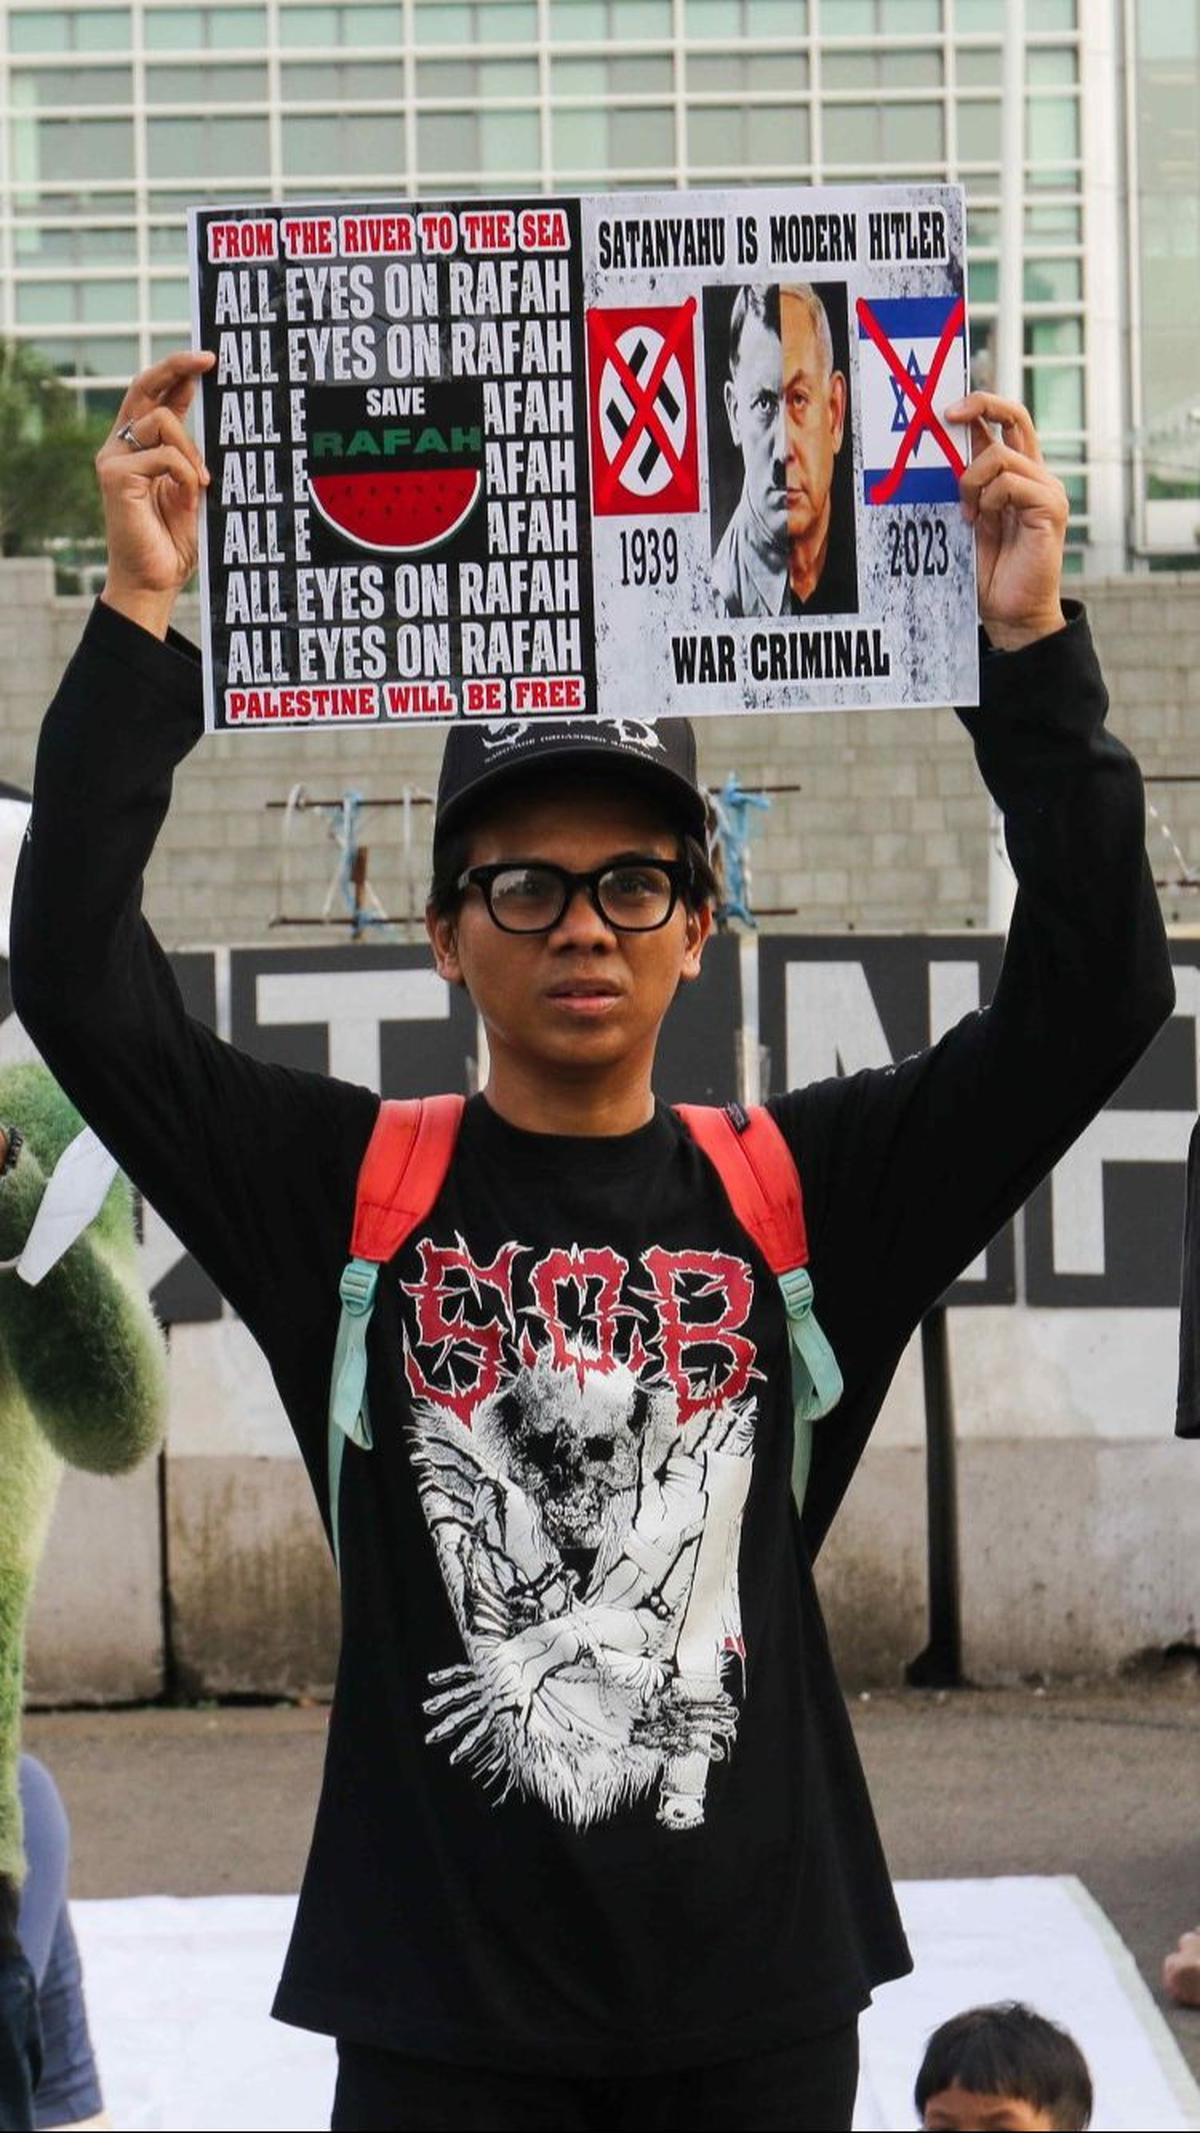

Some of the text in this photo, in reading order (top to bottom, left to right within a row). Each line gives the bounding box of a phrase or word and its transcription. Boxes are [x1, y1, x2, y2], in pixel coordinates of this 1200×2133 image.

[212, 214, 565, 258] FROM THE RIVER TO THE SEA
[599, 211, 945, 269] SATANYAHU IS MODERN HITLER
[215, 259, 570, 324] ALL EYES ON RAFAH
[217, 320, 572, 385] ALL EYES ON RAFAH
[219, 390, 280, 445] ALL
[483, 380, 573, 436] AFAH
[366, 387, 425, 416] SAVE
[313, 427, 482, 457] RAFAH
[222, 450, 283, 505] ALL
[485, 440, 575, 495] AFAH
[223, 510, 285, 564] ALL
[487, 500, 577, 555] AFAH
[620, 527, 678, 585] 1939
[889, 519, 949, 576] 2023
[225, 559, 579, 624] ALL EYES ON RAFAH
[227, 619, 581, 683] ALL EYES ON RAFAH
[672, 629, 890, 684] WAR CRIMINAL
[230, 680, 580, 719] PALESTINE WILL BE FREE
